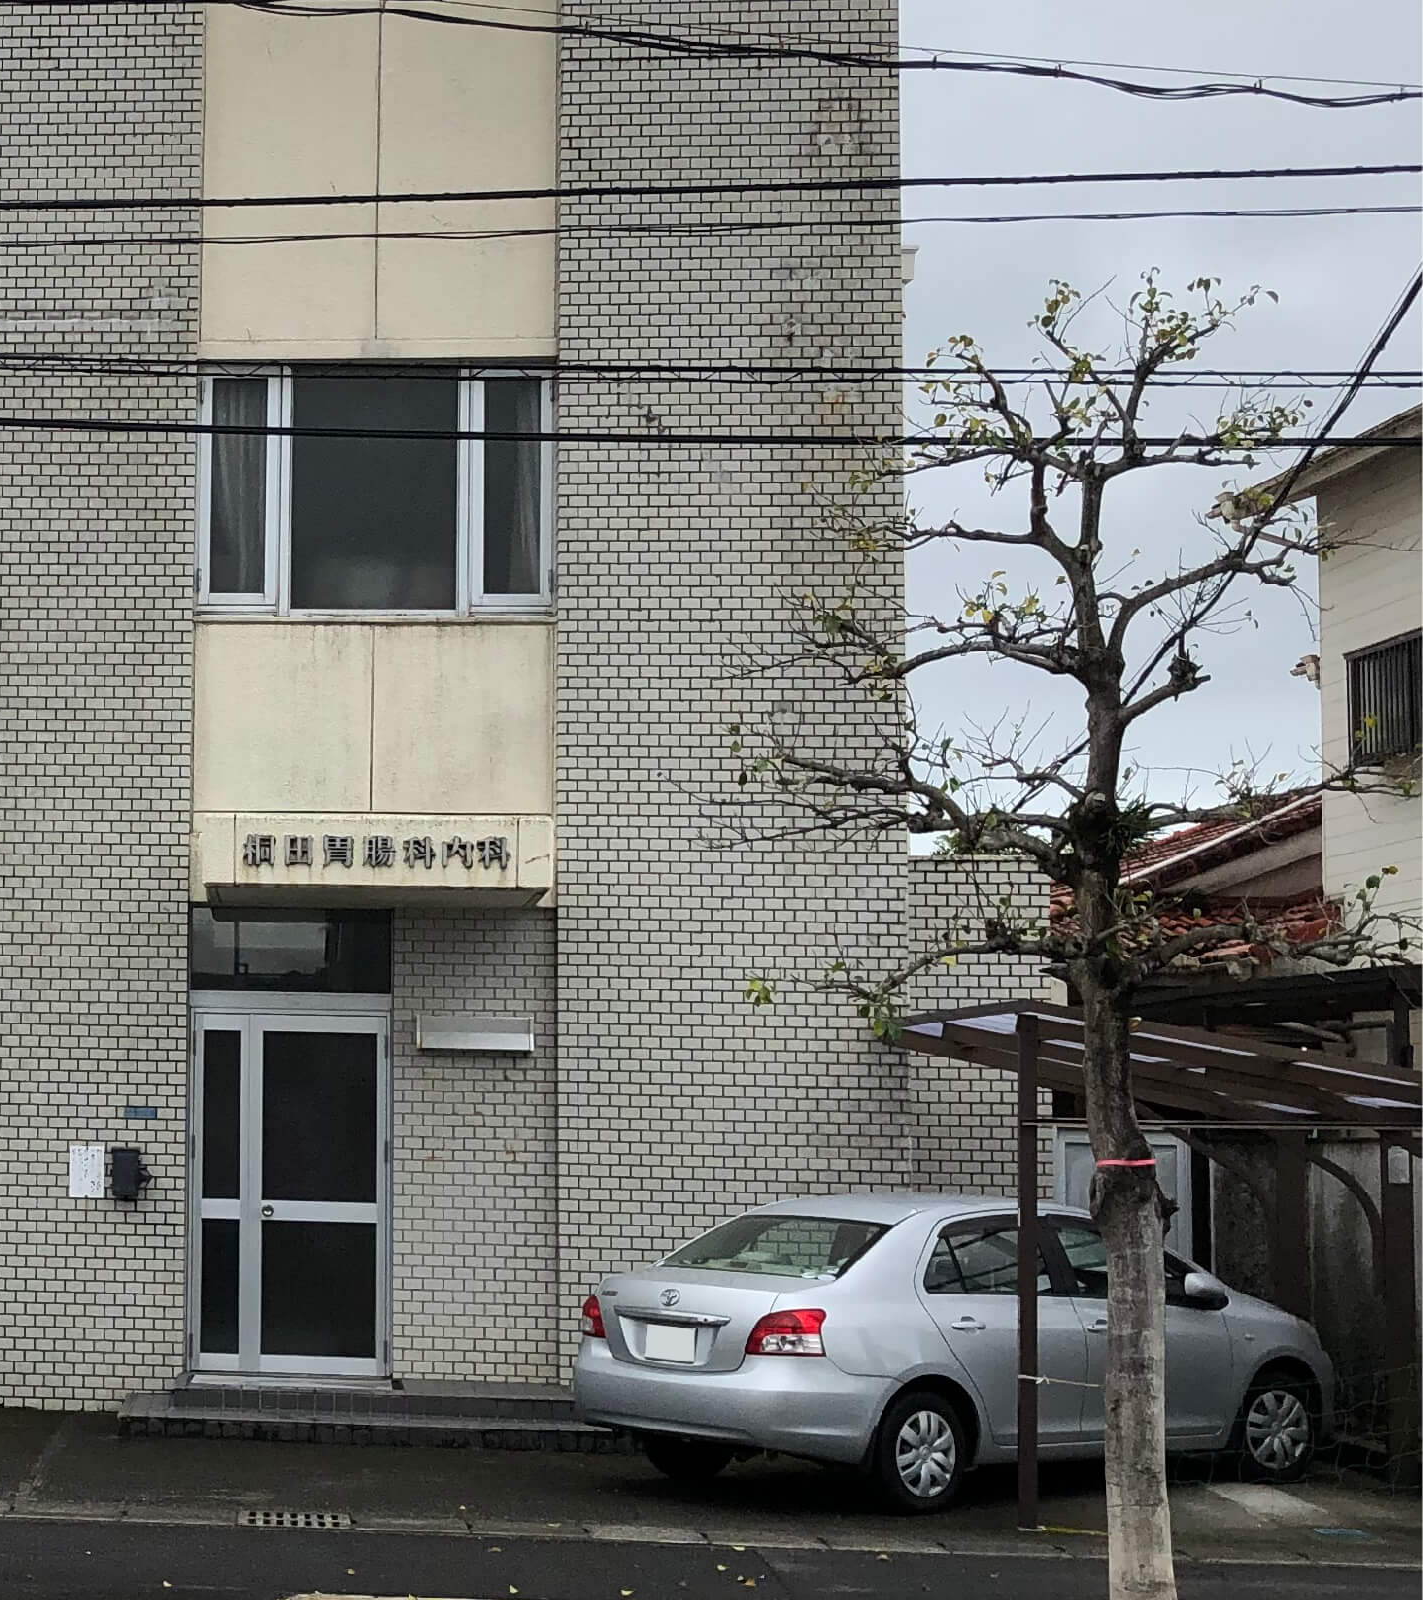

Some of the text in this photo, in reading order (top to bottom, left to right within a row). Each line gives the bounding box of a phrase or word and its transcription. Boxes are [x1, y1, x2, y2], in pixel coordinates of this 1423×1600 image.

[243, 834, 510, 869] 桐田胃腸科内科
